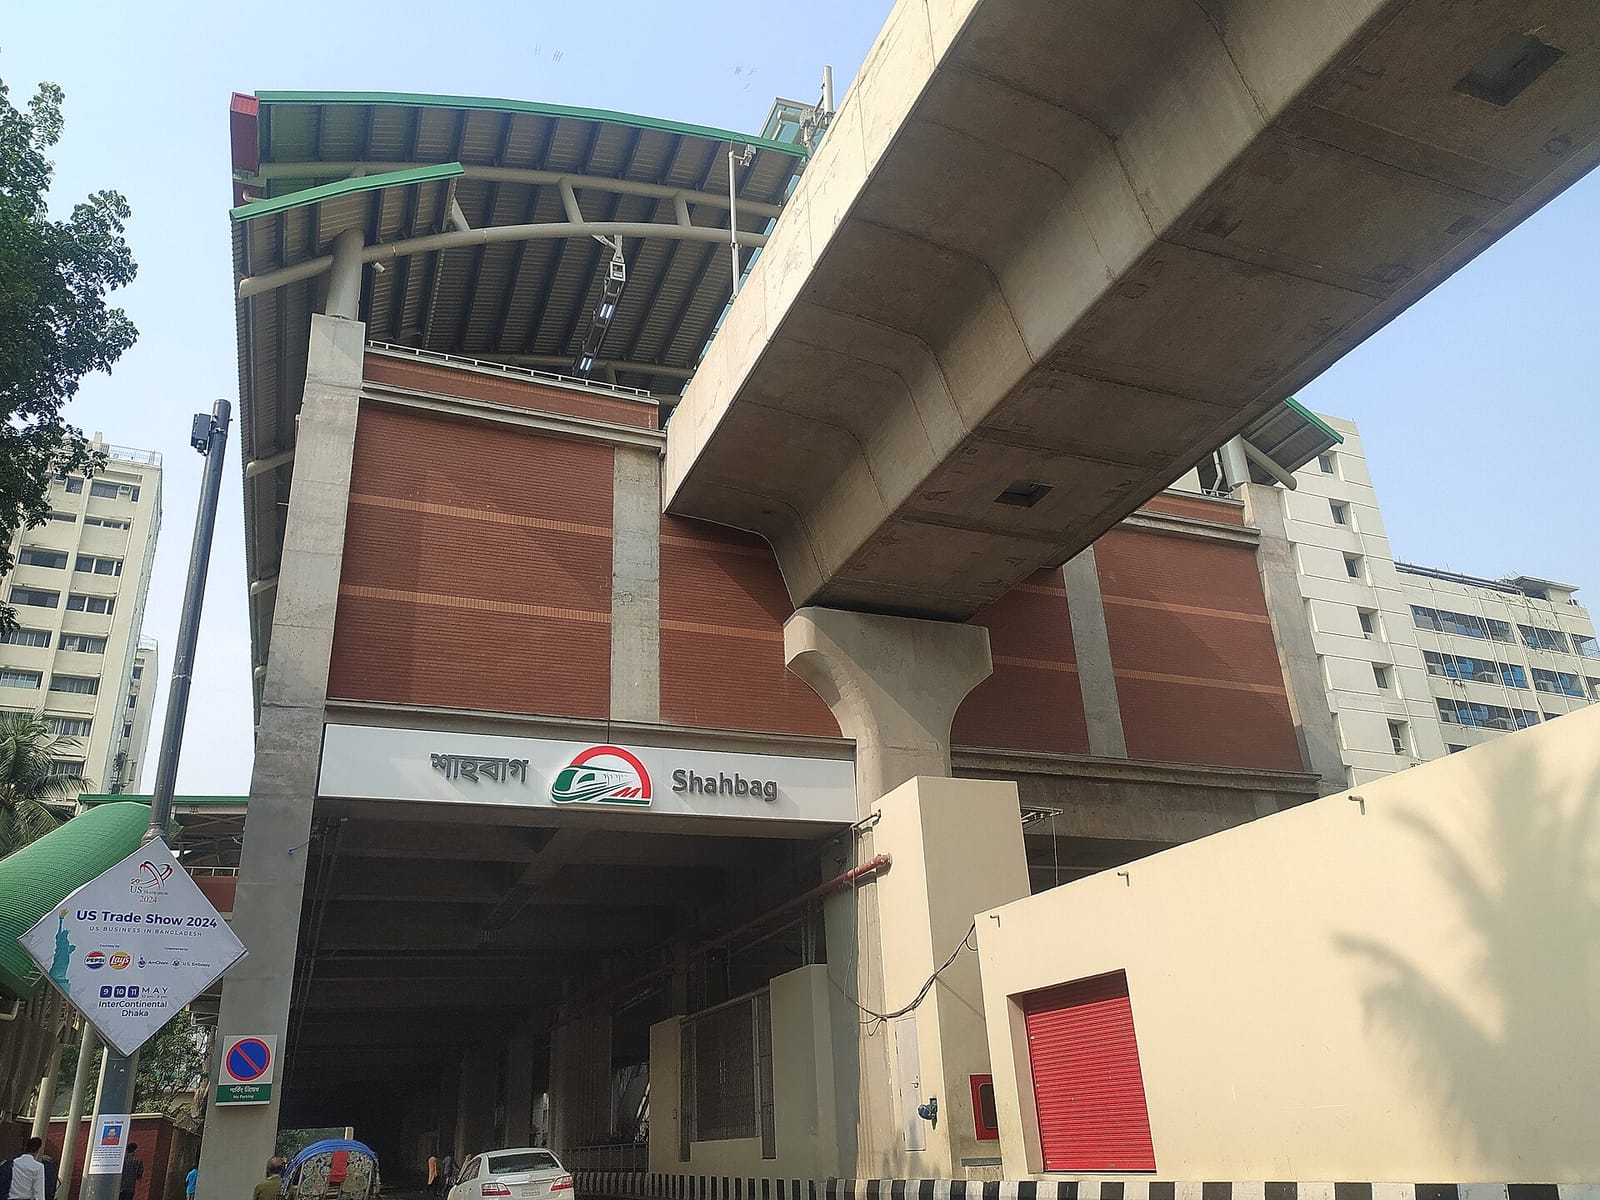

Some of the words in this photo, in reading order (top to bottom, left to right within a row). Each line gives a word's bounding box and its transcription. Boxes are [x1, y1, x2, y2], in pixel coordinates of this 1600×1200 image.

[430, 752, 530, 784] শাহবাগ
[672, 769, 779, 802] Shahbag
[130, 885, 143, 893] US
[139, 895, 157, 903] 2024
[76, 910, 97, 921] US
[101, 911, 142, 923] Trade
[145, 913, 184, 926] Show
[186, 916, 218, 928] 2024
[155, 929, 202, 937] BANGLADESH
[98, 1000, 168, 1008] InterContinental
[121, 1009, 149, 1017] Dhaka
